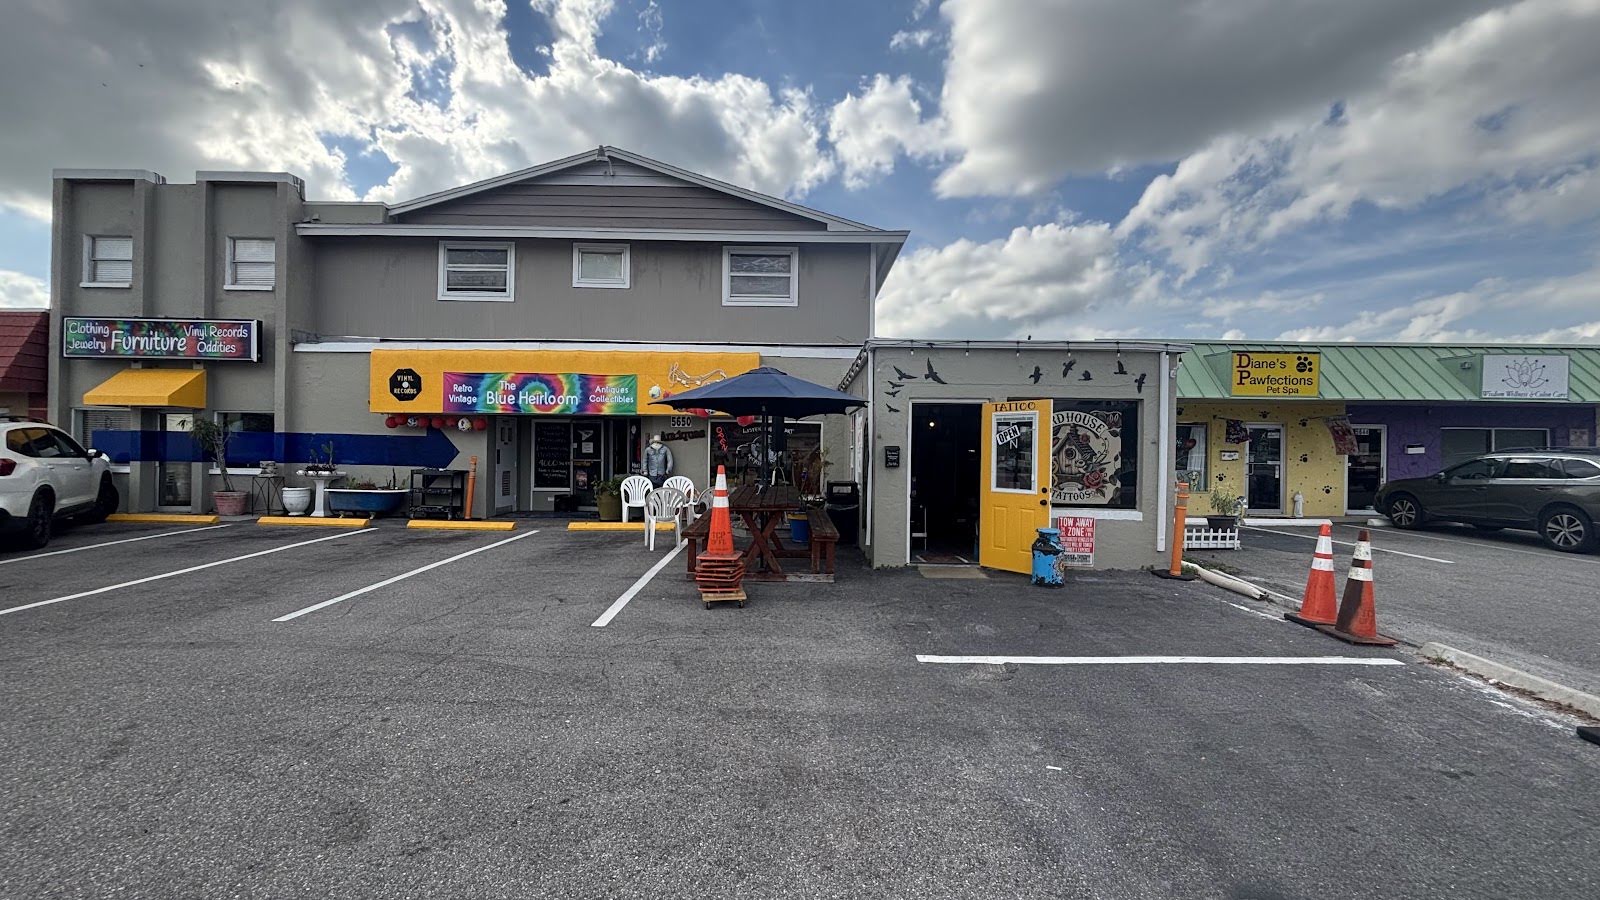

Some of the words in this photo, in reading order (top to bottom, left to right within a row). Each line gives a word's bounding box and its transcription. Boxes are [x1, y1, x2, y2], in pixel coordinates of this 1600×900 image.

[68, 322, 109, 336] Clothing
[183, 324, 207, 340] Vinyl
[210, 325, 248, 338] Records
[69, 338, 106, 353] Jewelry
[111, 330, 187, 351] Furniture
[197, 341, 236, 353] Oddities
[1236, 353, 1287, 369] Diane's
[396, 374, 414, 382] VINYL
[1236, 370, 1314, 386] Pawfections
[393, 387, 417, 395] RECORDS
[453, 383, 473, 393] Retro
[500, 380, 517, 391] The
[595, 385, 629, 394] Antiques
[1266, 386, 1280, 394] Pet
[1282, 386, 1299, 395] Spa
[448, 394, 477, 405] Vintage
[486, 391, 516, 405] Blue
[518, 391, 579, 405] Heirloom
[589, 394, 634, 404] Collectibles
[992, 402, 1037, 412] TATTOO
[671, 416, 692, 427] 5650
[998, 426, 1019, 443] OPEN
[1060, 517, 1074, 527] TOW
[1076, 518, 1094, 528] AWAY
[1067, 527, 1085, 537] ZONE
